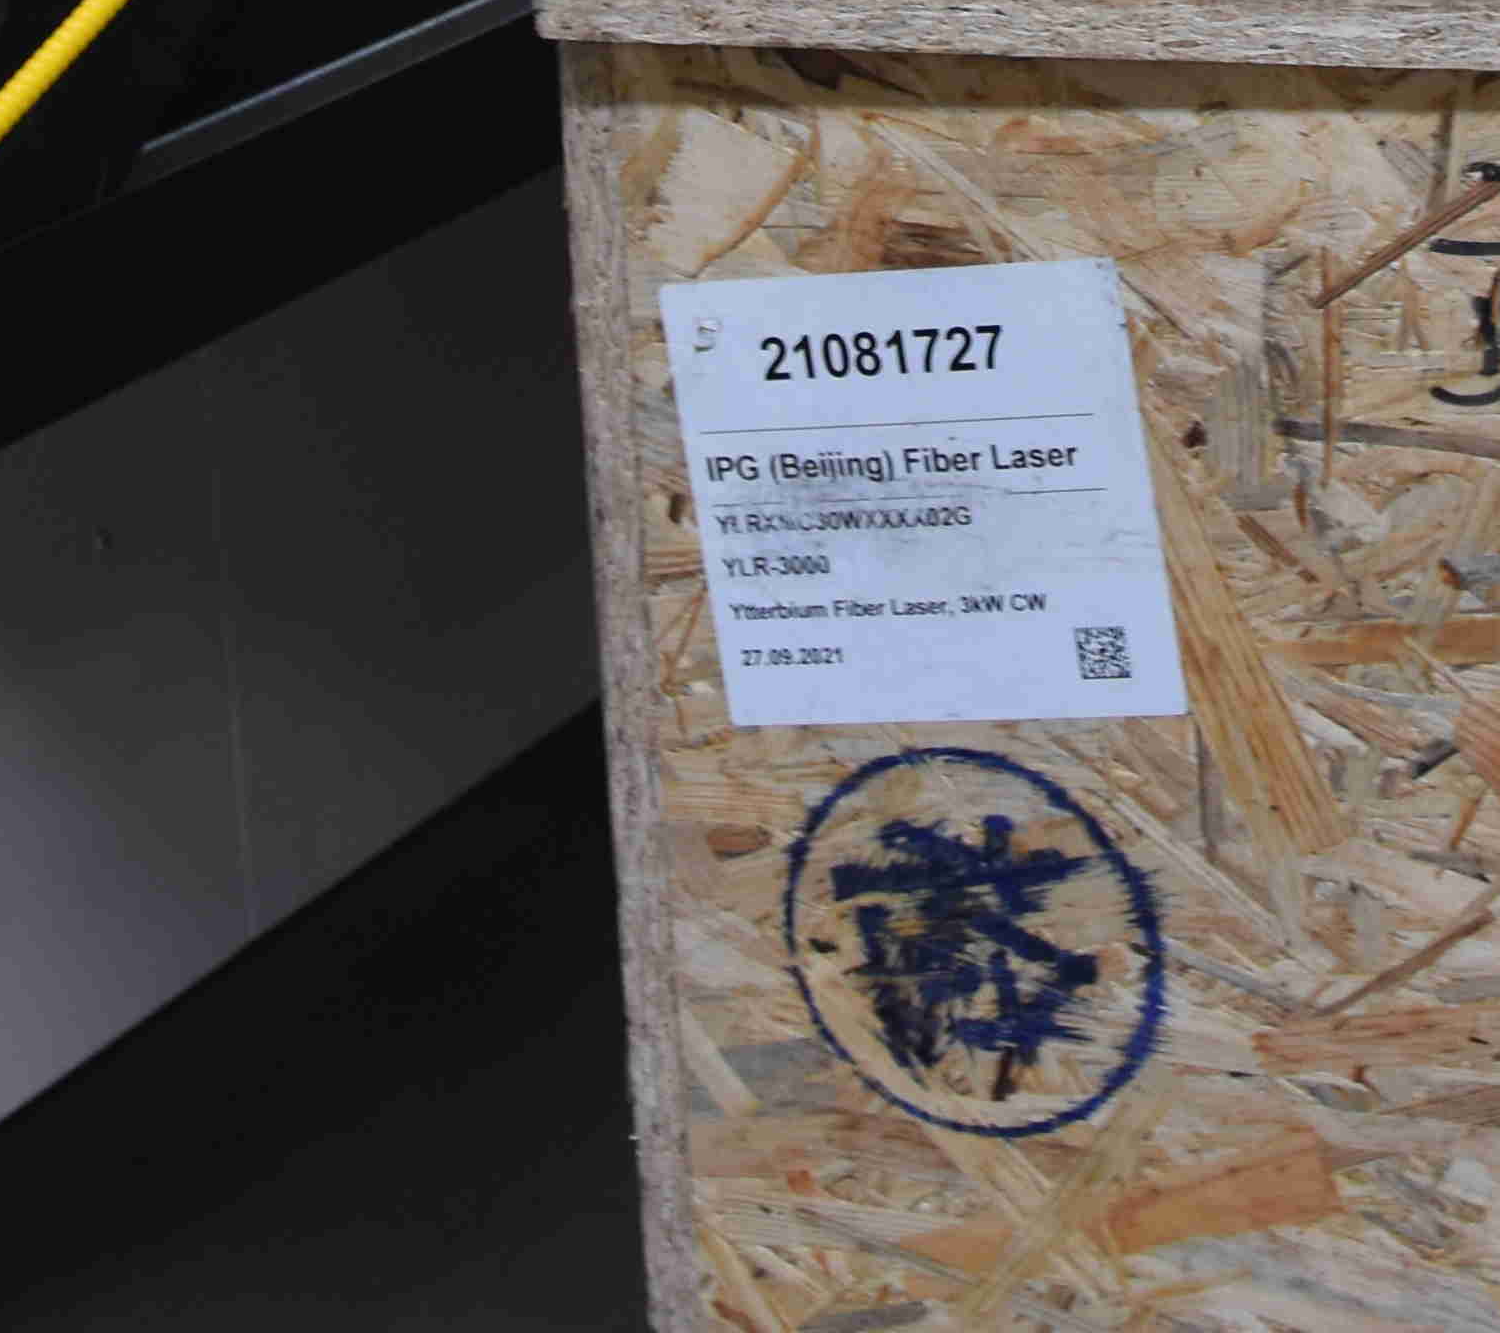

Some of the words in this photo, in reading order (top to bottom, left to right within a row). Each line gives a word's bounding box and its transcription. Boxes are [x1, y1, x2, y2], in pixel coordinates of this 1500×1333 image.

[759, 324, 1004, 382] 21081727
[705, 454, 760, 483] IPG
[768, 450, 895, 485] (Beijing)
[902, 447, 982, 475] Fiber
[990, 443, 1078, 471] Laser
[722, 554, 832, 578] YLR-3000
[729, 601, 827, 621] Ytterbium
[832, 598, 885, 617] Fiber
[960, 594, 1003, 614] 3kW
[1009, 592, 1047, 612] CW
